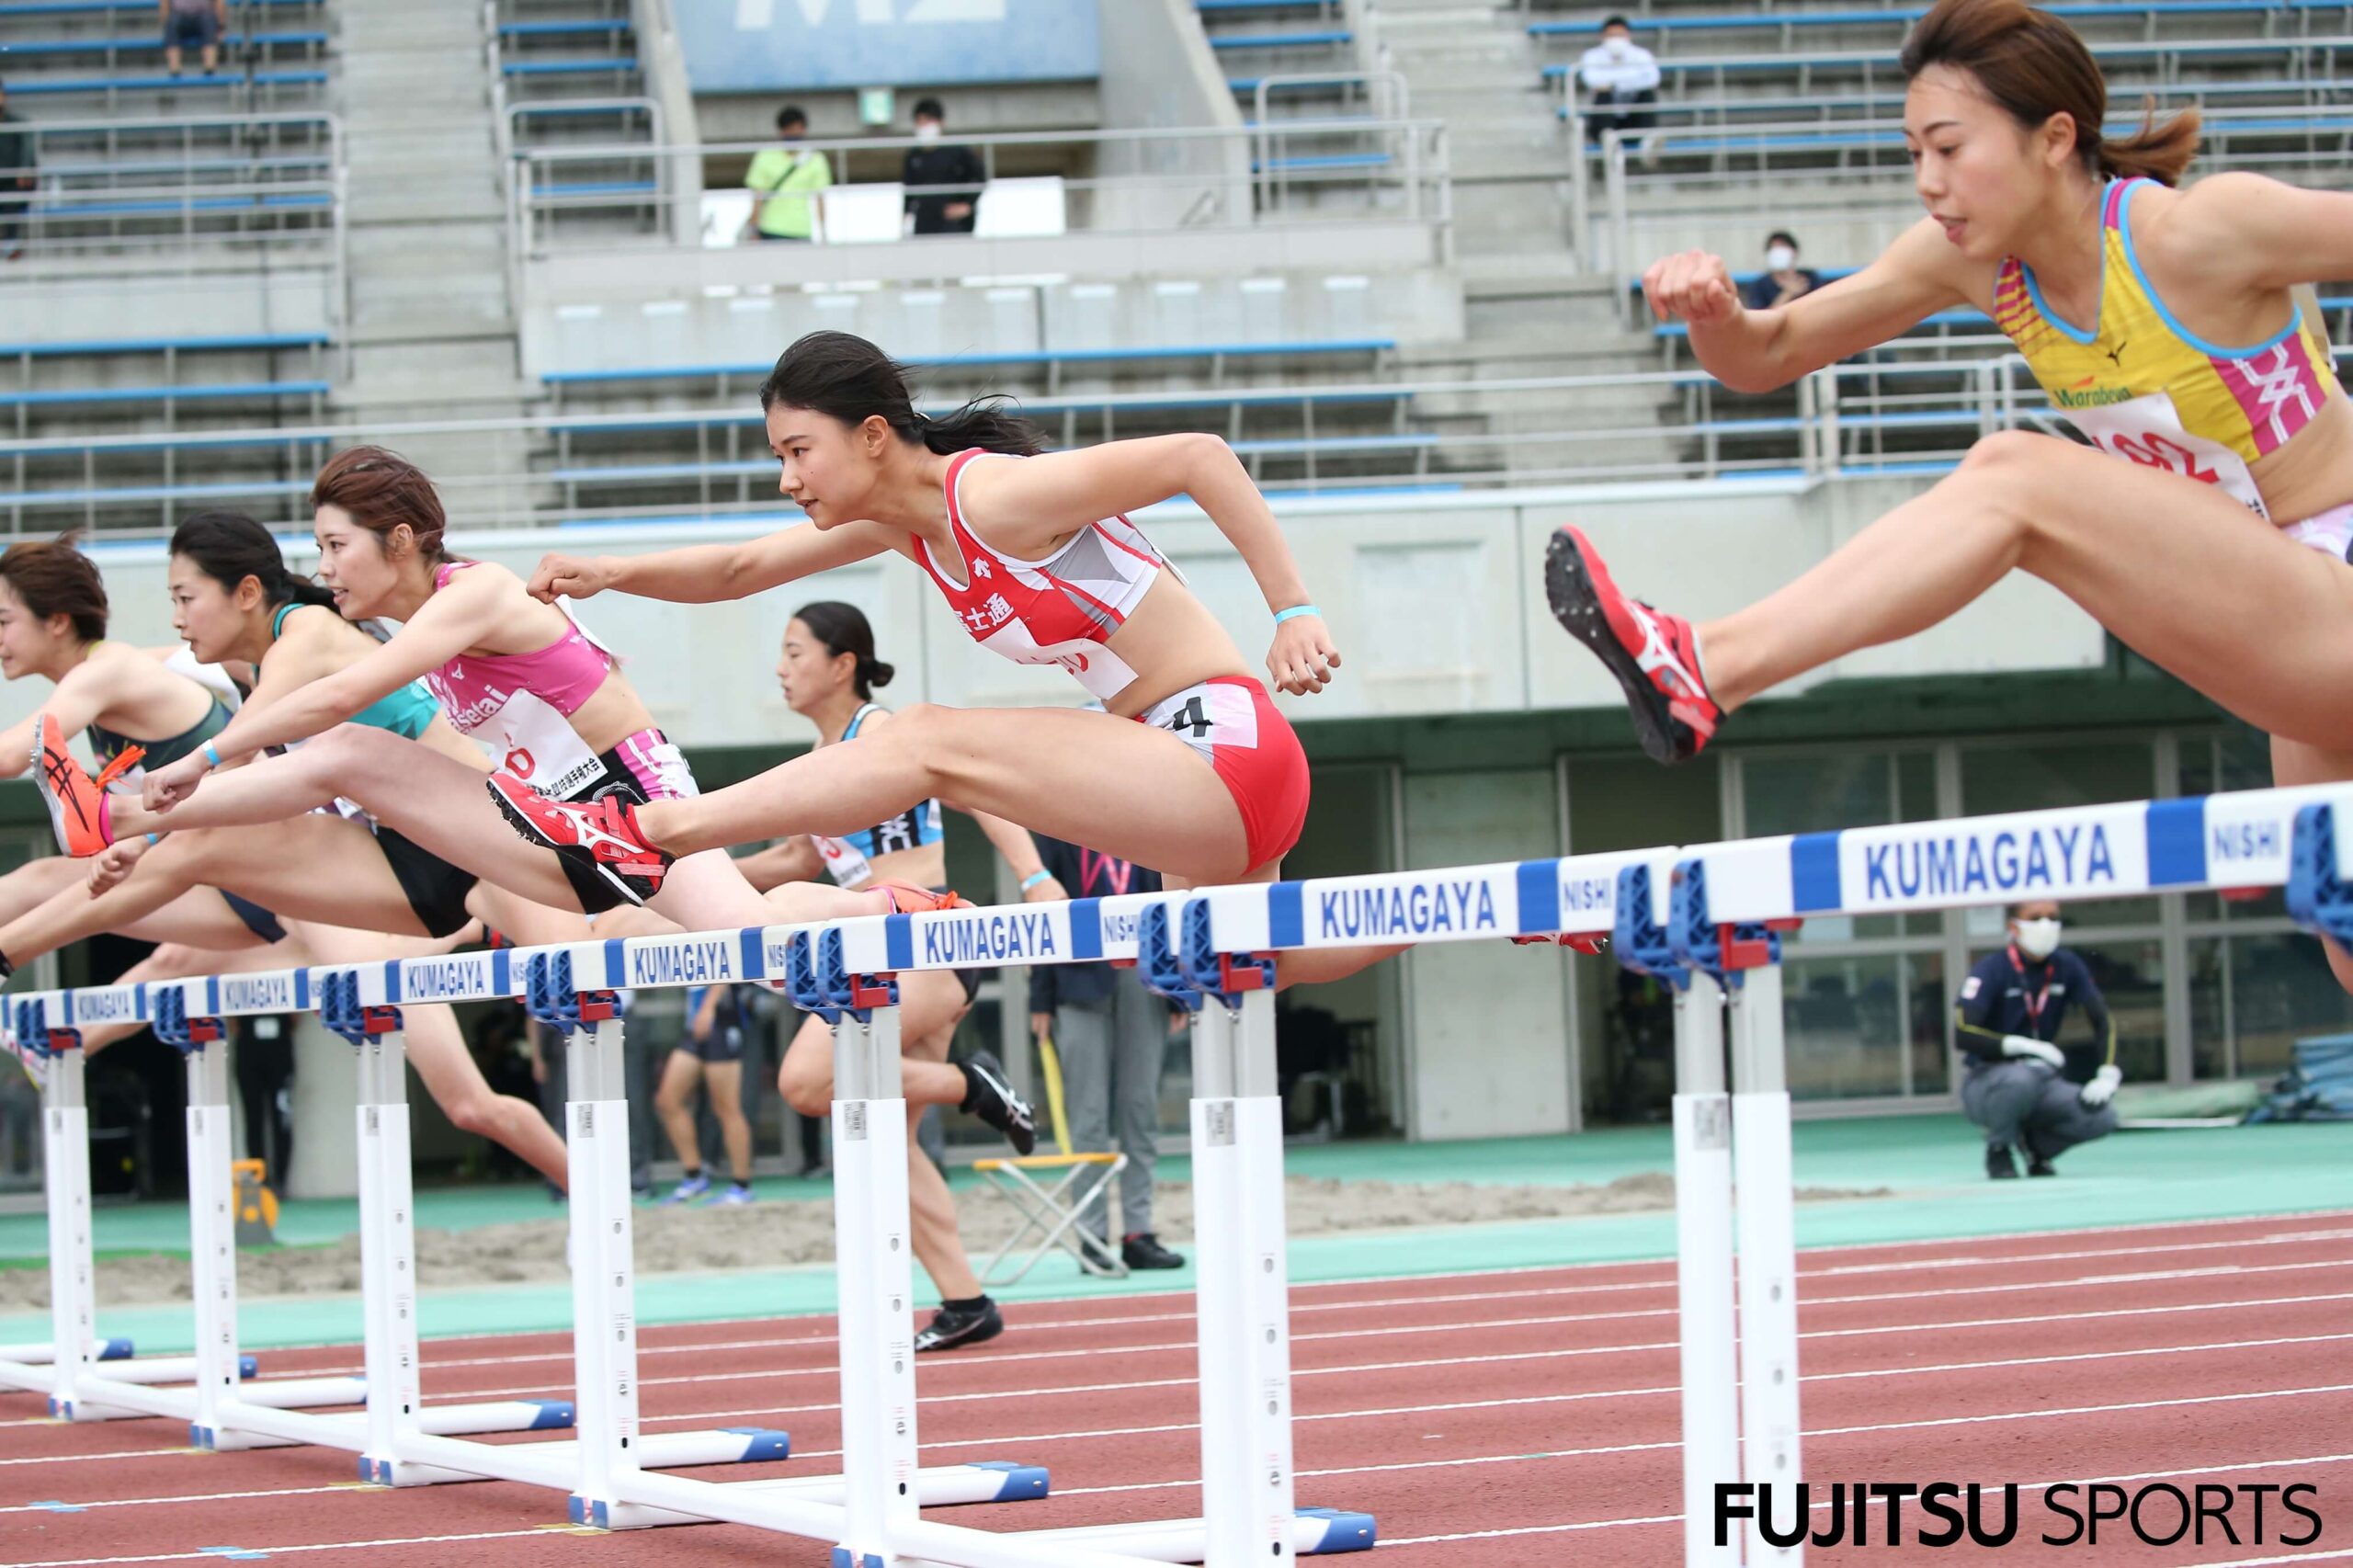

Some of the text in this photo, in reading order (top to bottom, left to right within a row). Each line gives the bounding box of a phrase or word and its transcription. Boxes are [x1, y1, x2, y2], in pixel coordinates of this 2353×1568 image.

[1172, 696, 1214, 738] 4
[1865, 819, 2280, 900] KUMAGAYA NISHI
[1321, 878, 1612, 938] KUMAGAYA NISHI
[924, 912, 1057, 964] KUMAGAYA
[407, 960, 485, 998] KUMAGAYA
[633, 941, 732, 984] KUMAGAYA
[224, 977, 290, 1010] KUMAGAYA
